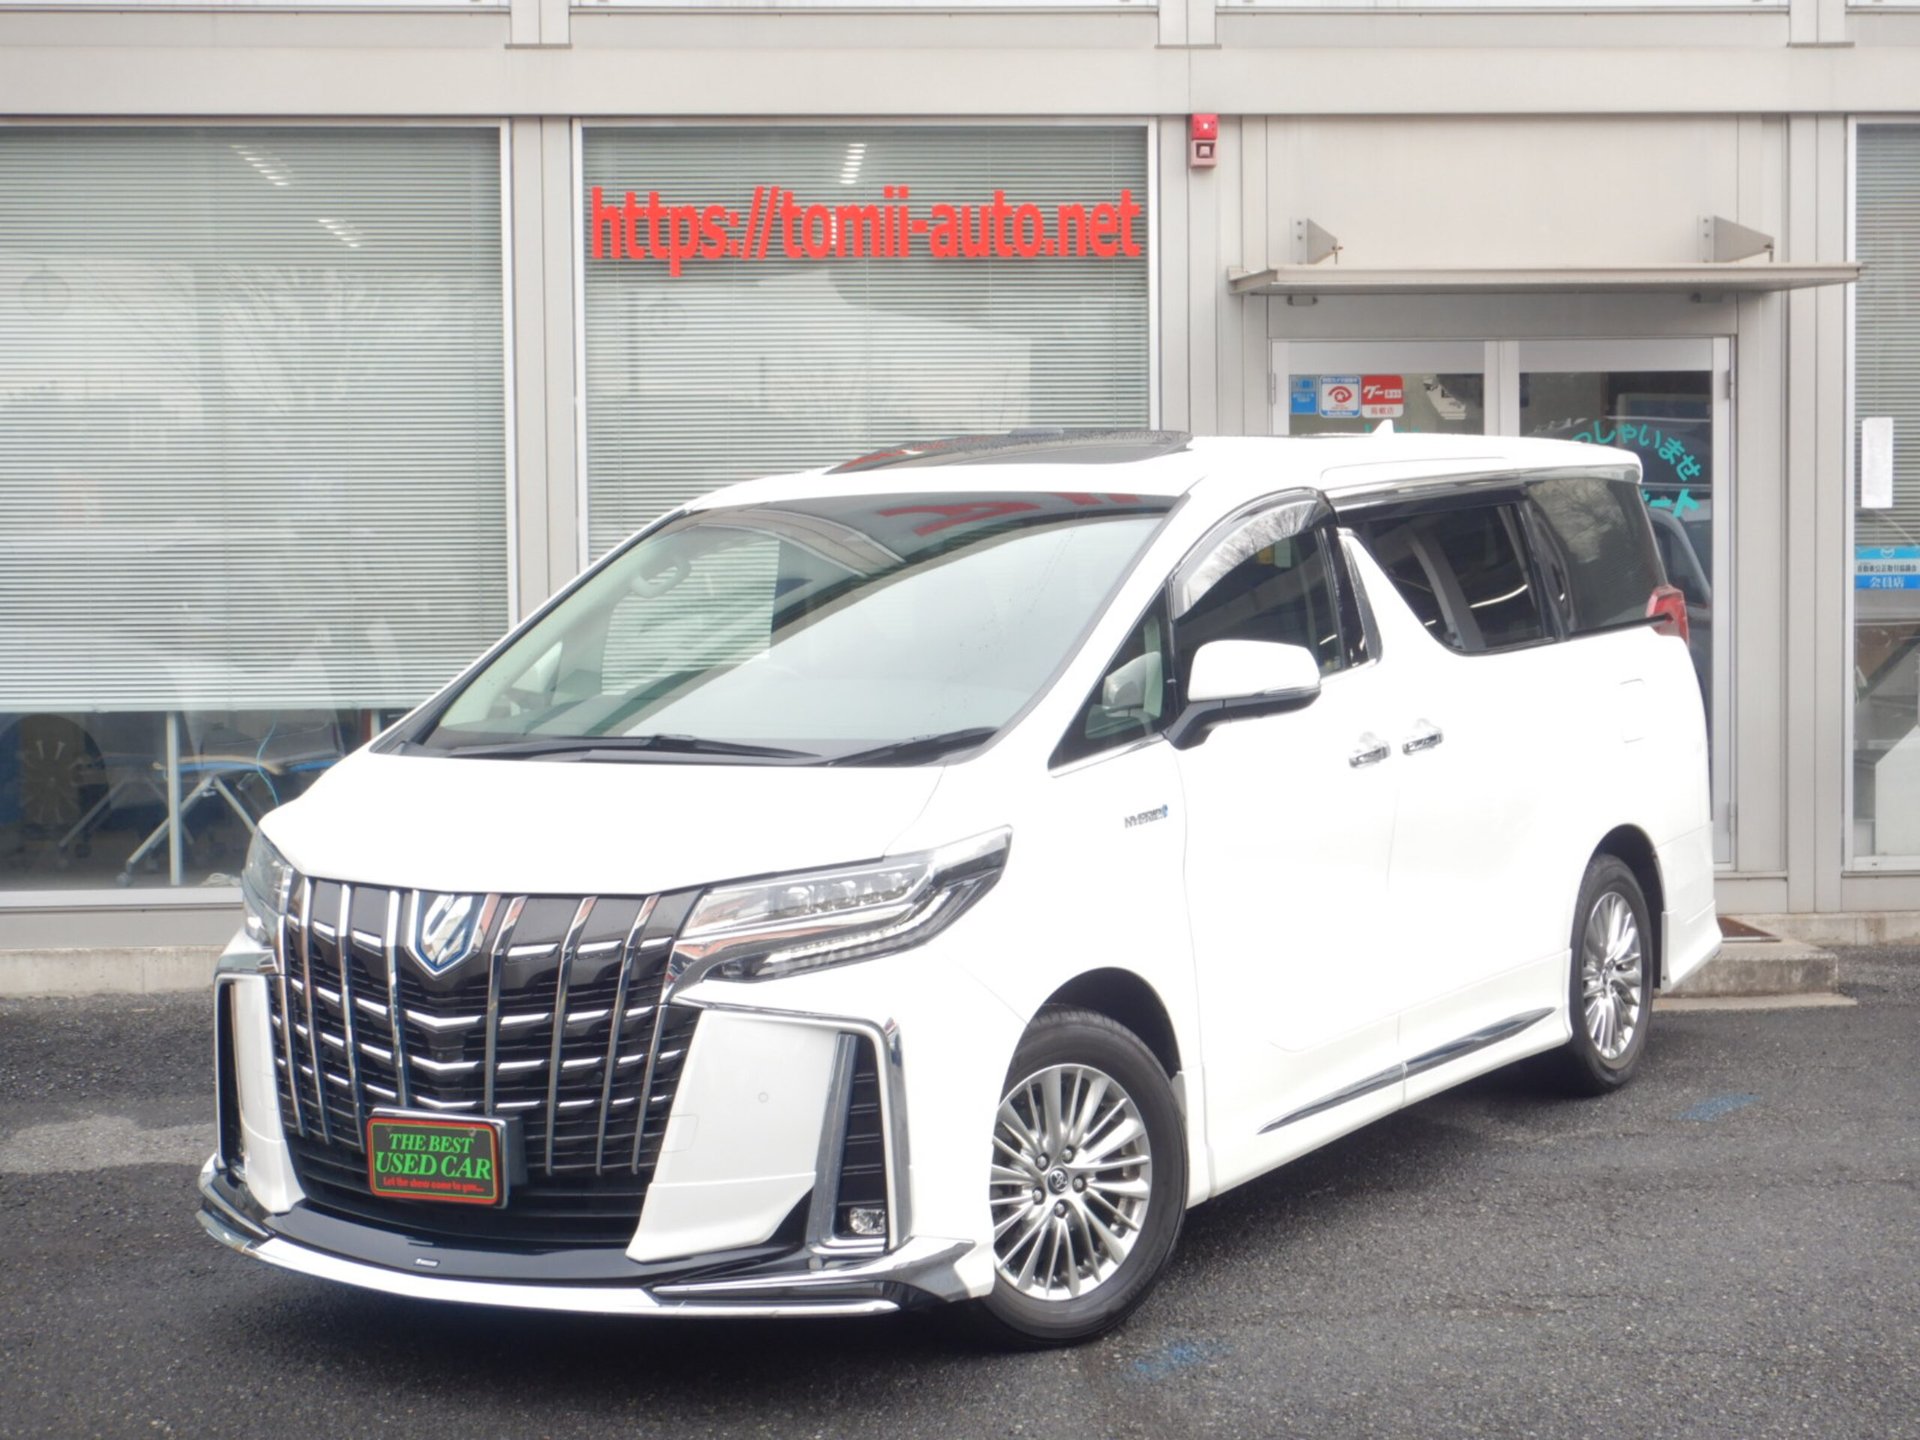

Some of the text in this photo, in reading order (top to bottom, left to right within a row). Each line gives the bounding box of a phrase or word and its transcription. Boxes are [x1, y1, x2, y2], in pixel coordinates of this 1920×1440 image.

[591, 186, 1140, 277] https://tomii-auto.net
[389, 1133, 475, 1154] THE BEST
[376, 1151, 491, 1180] USED CAR
